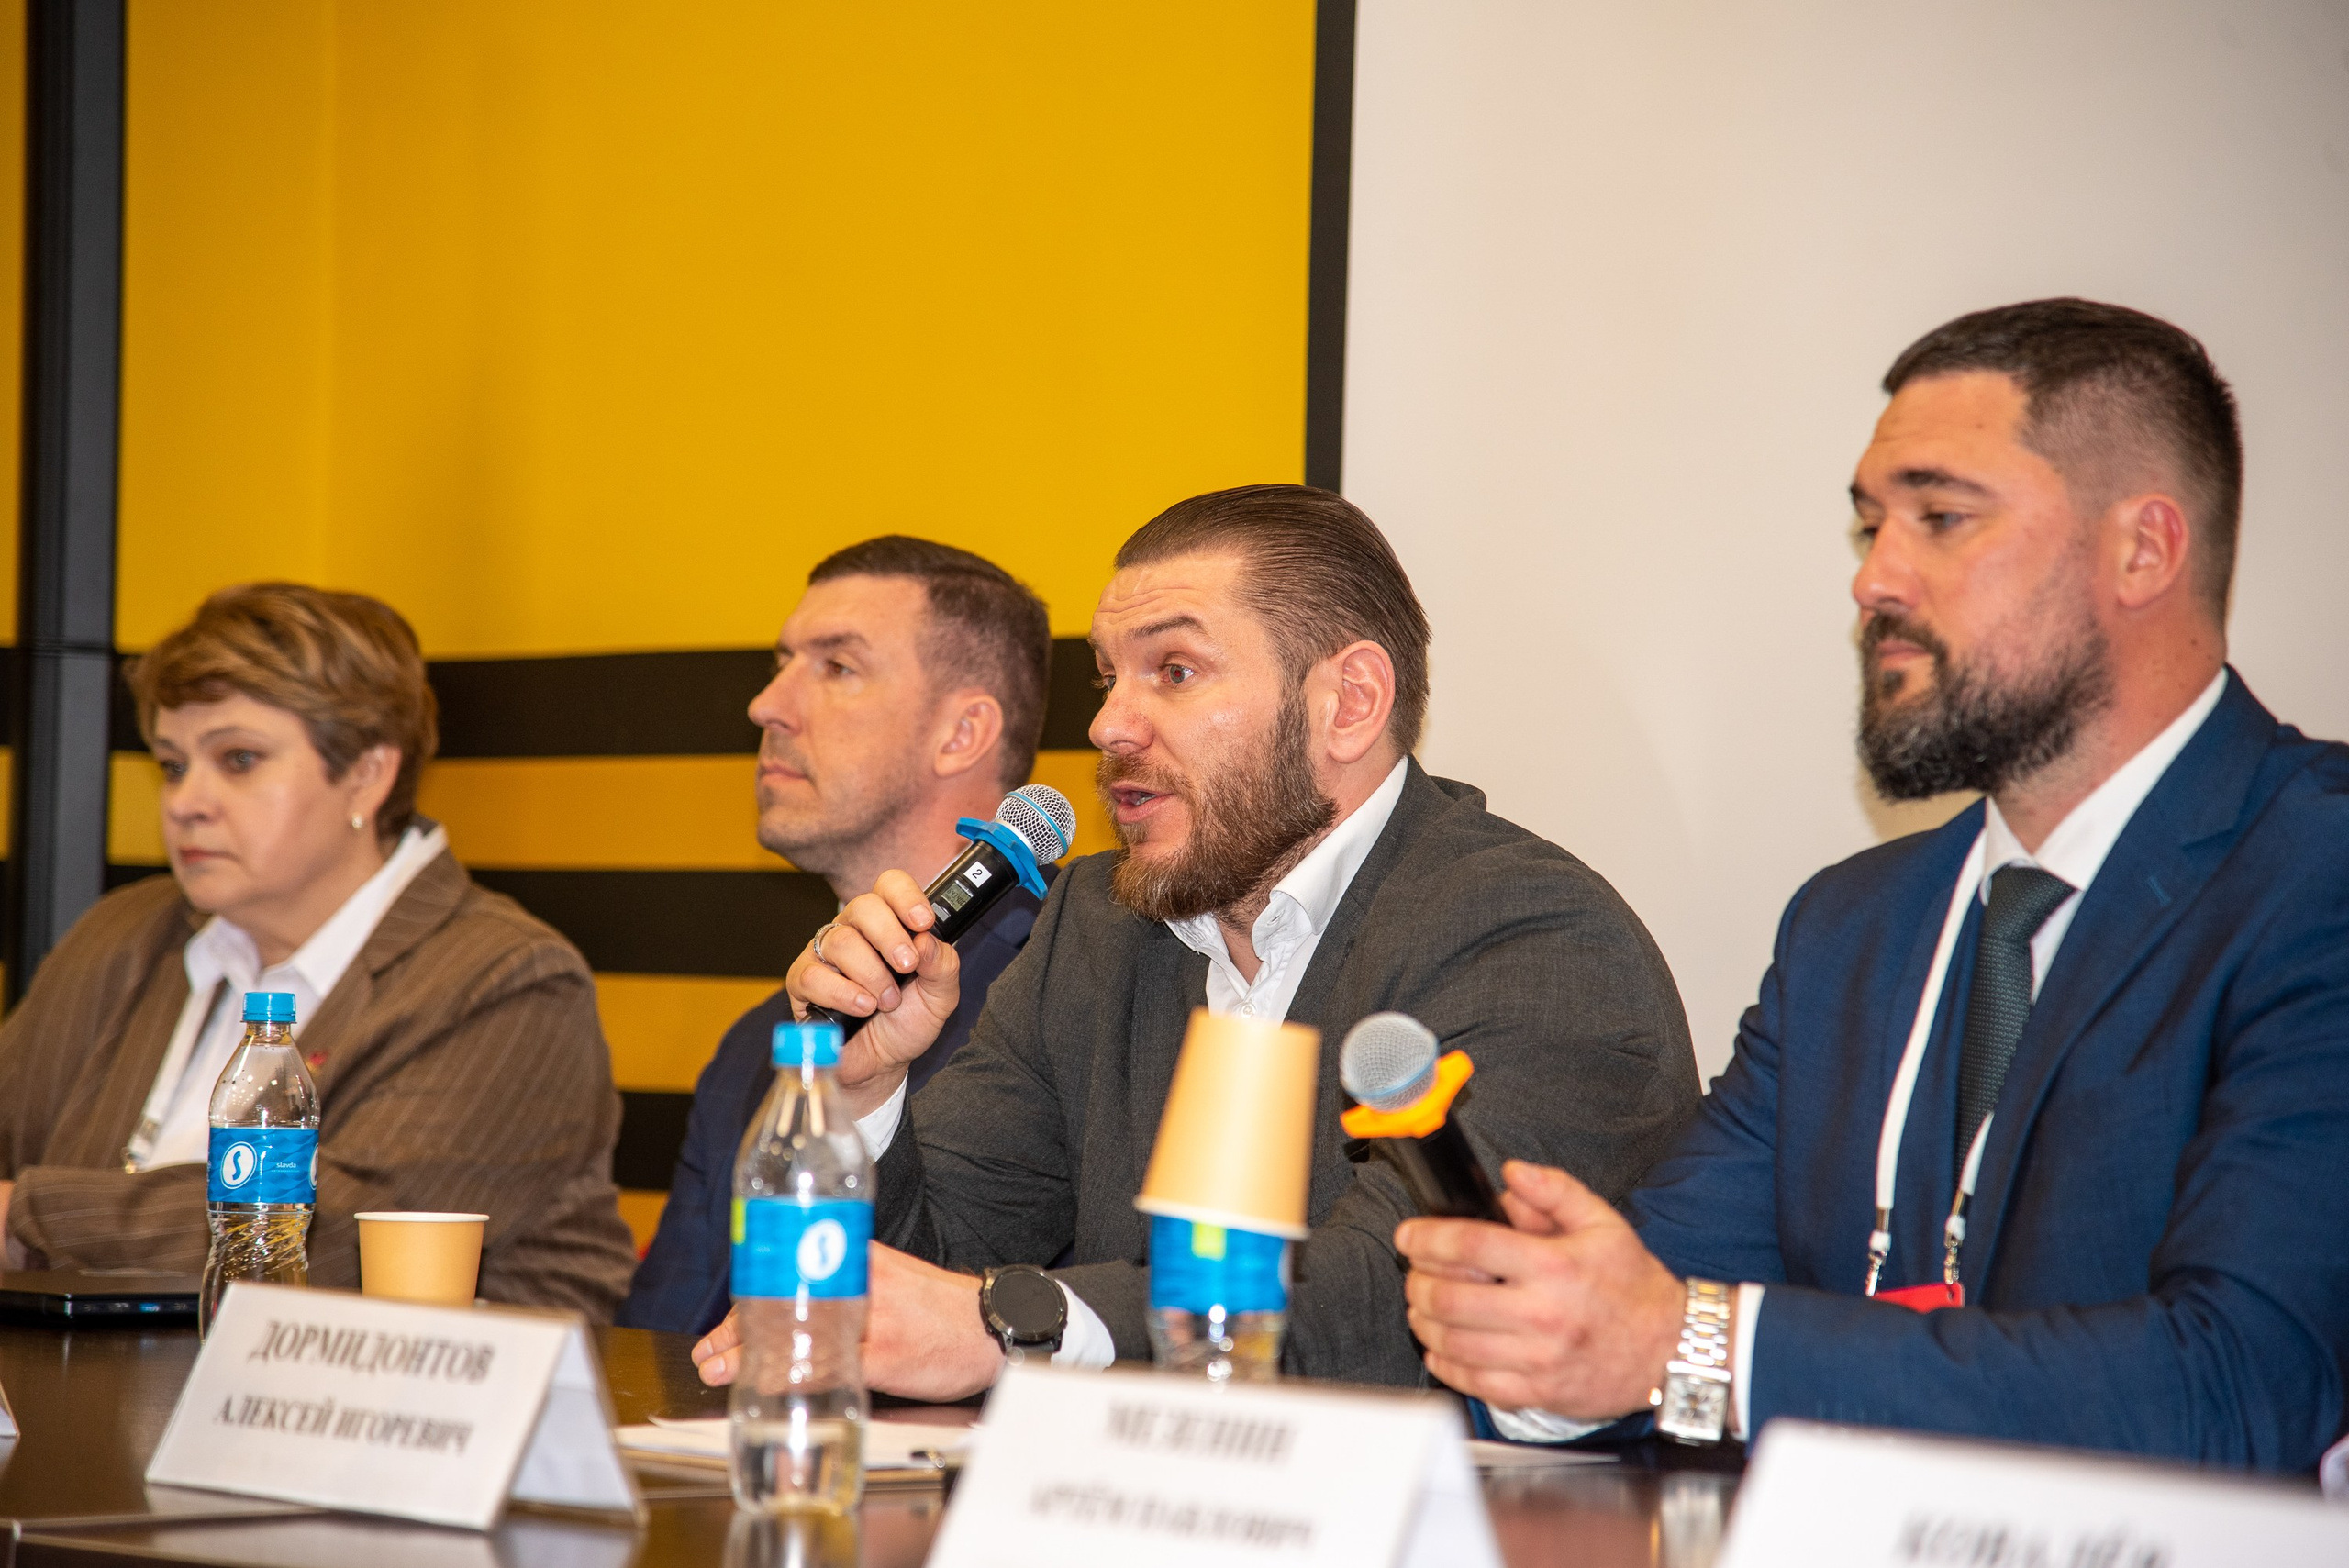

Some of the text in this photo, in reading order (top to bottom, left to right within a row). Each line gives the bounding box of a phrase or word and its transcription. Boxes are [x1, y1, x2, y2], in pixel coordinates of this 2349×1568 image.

[972, 868, 983, 879] 2
[247, 1319, 496, 1383] ДОРМИДОНТОВ
[213, 1395, 335, 1438] АЛЕКСЕЙ
